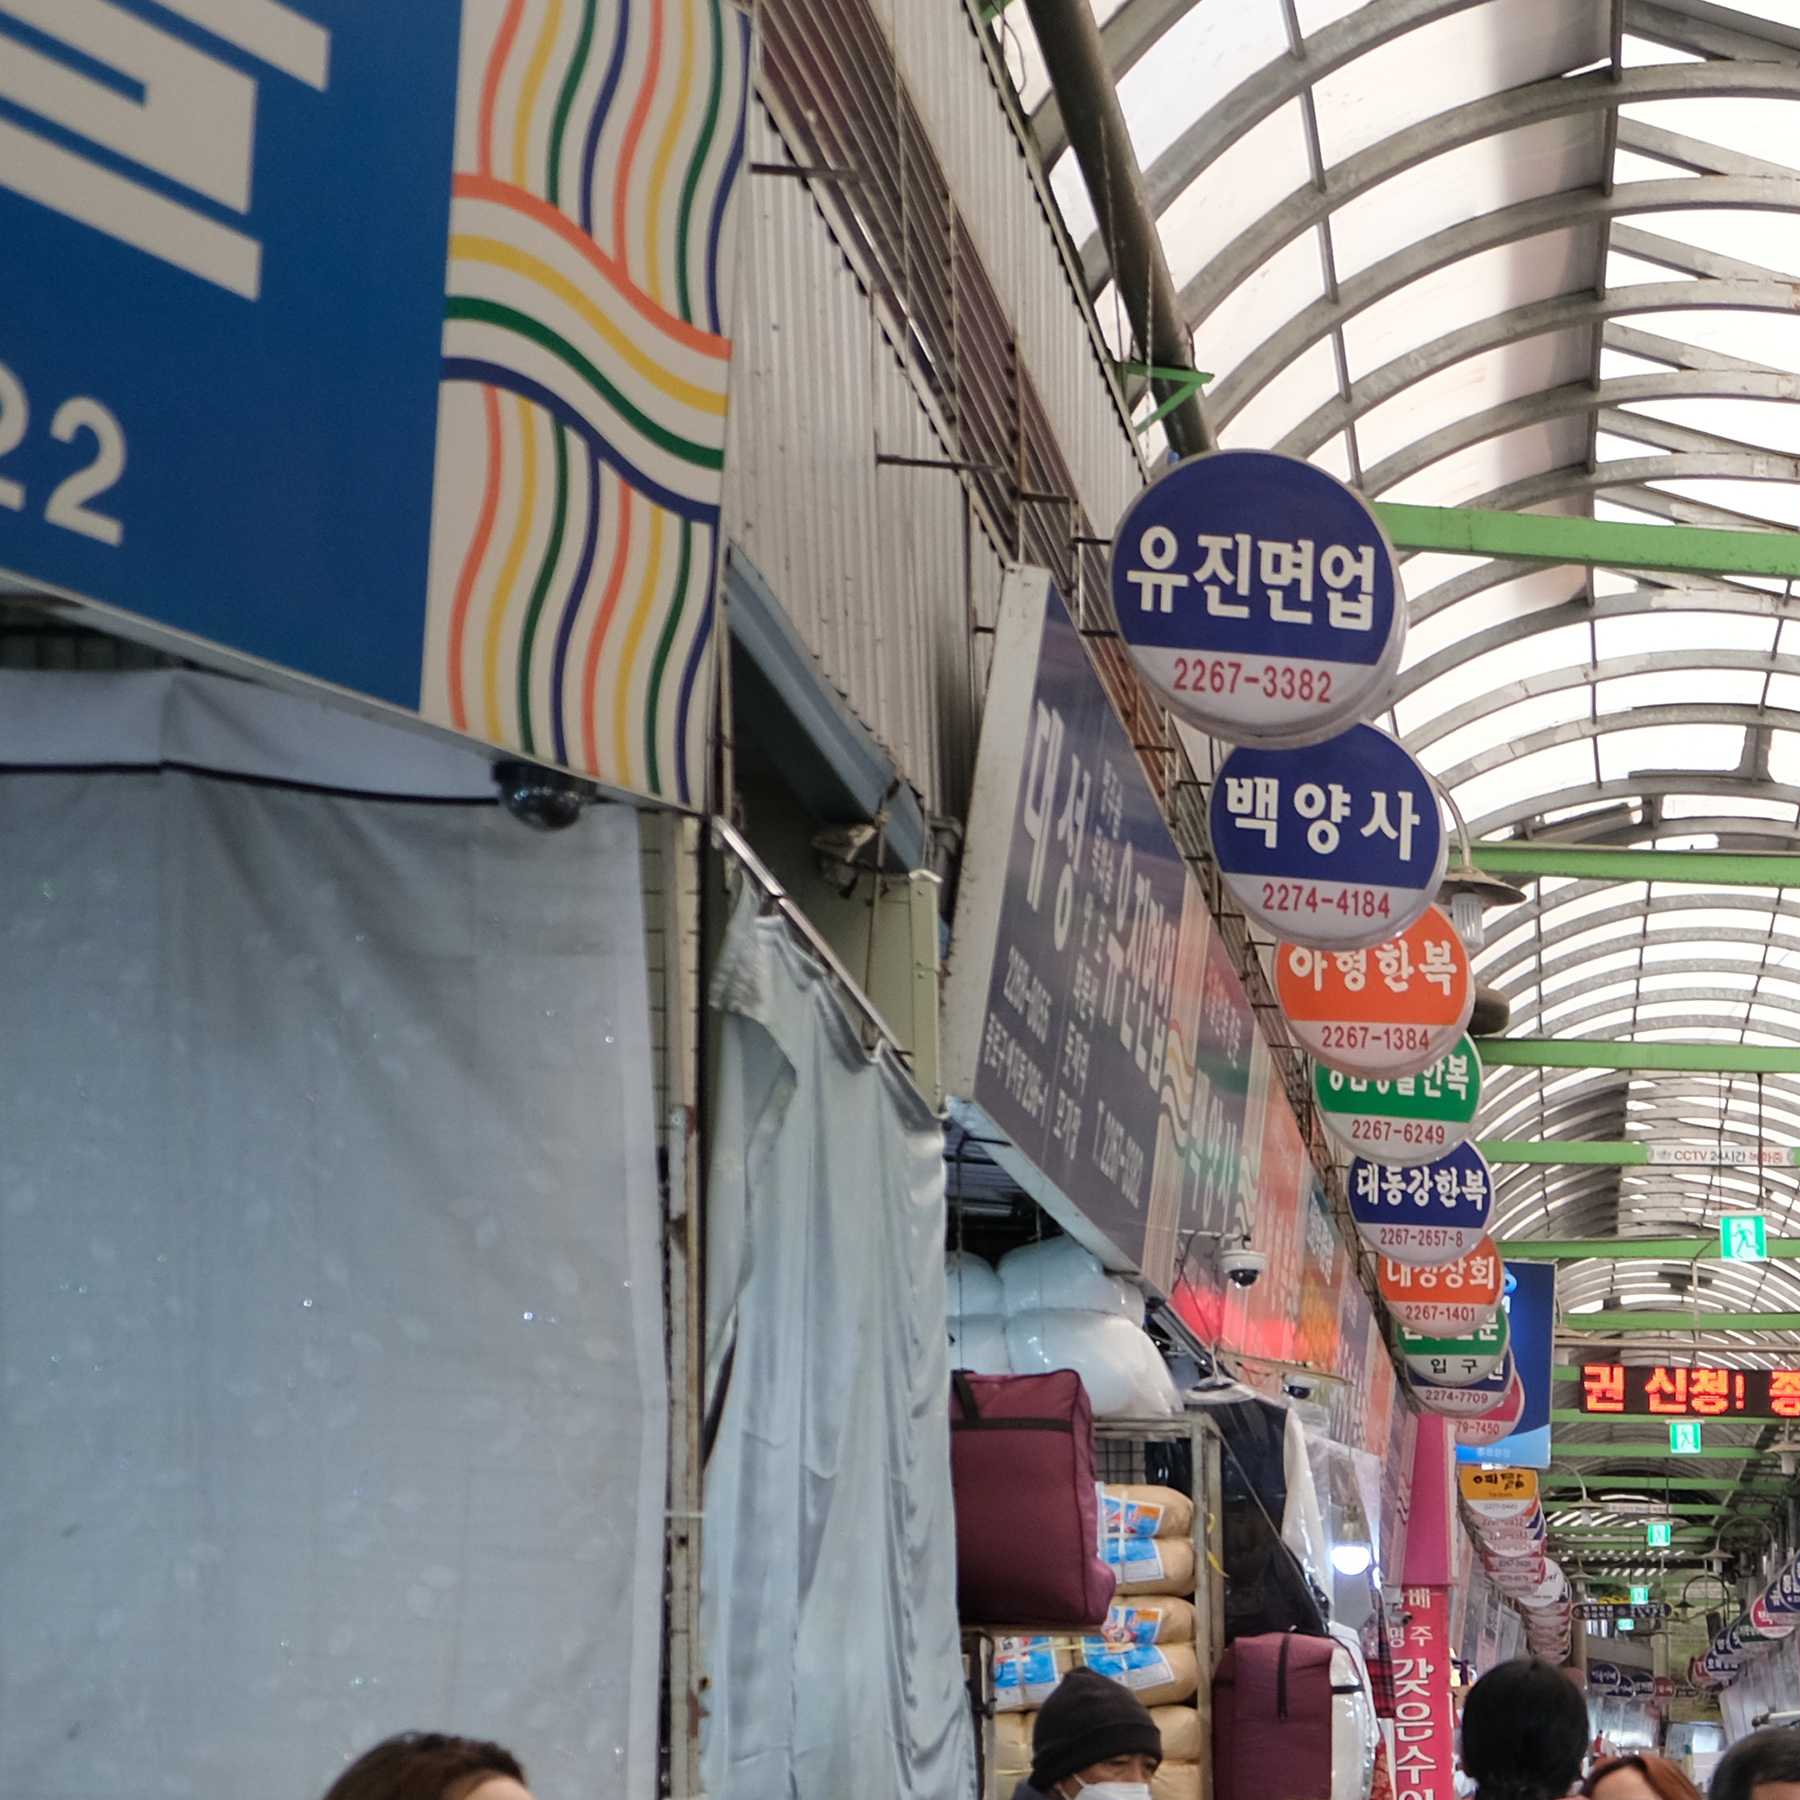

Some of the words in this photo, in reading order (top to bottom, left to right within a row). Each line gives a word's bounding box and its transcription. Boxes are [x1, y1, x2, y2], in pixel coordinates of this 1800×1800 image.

[1127, 525, 1375, 632] 유진면업
[1173, 657, 1332, 704] 2267-3382
[1225, 776, 1420, 861] 백양사
[1262, 883, 1391, 919] 2274-4184
[1322, 1026, 1429, 1050] 2267-1384
[1352, 1120, 1445, 1144] 2267-6249
[1674, 1150, 1708, 1162] CCTV
[1357, 1163, 1487, 1211] 대동강한복
[1406, 1306, 1475, 1322] 2267-1401
[1425, 1390, 1488, 1404] 2274-7709
[1584, 1364, 1625, 1412] 권
[1645, 1366, 1745, 1414] 신청!
[1457, 1421, 1500, 1436] 79-7450
